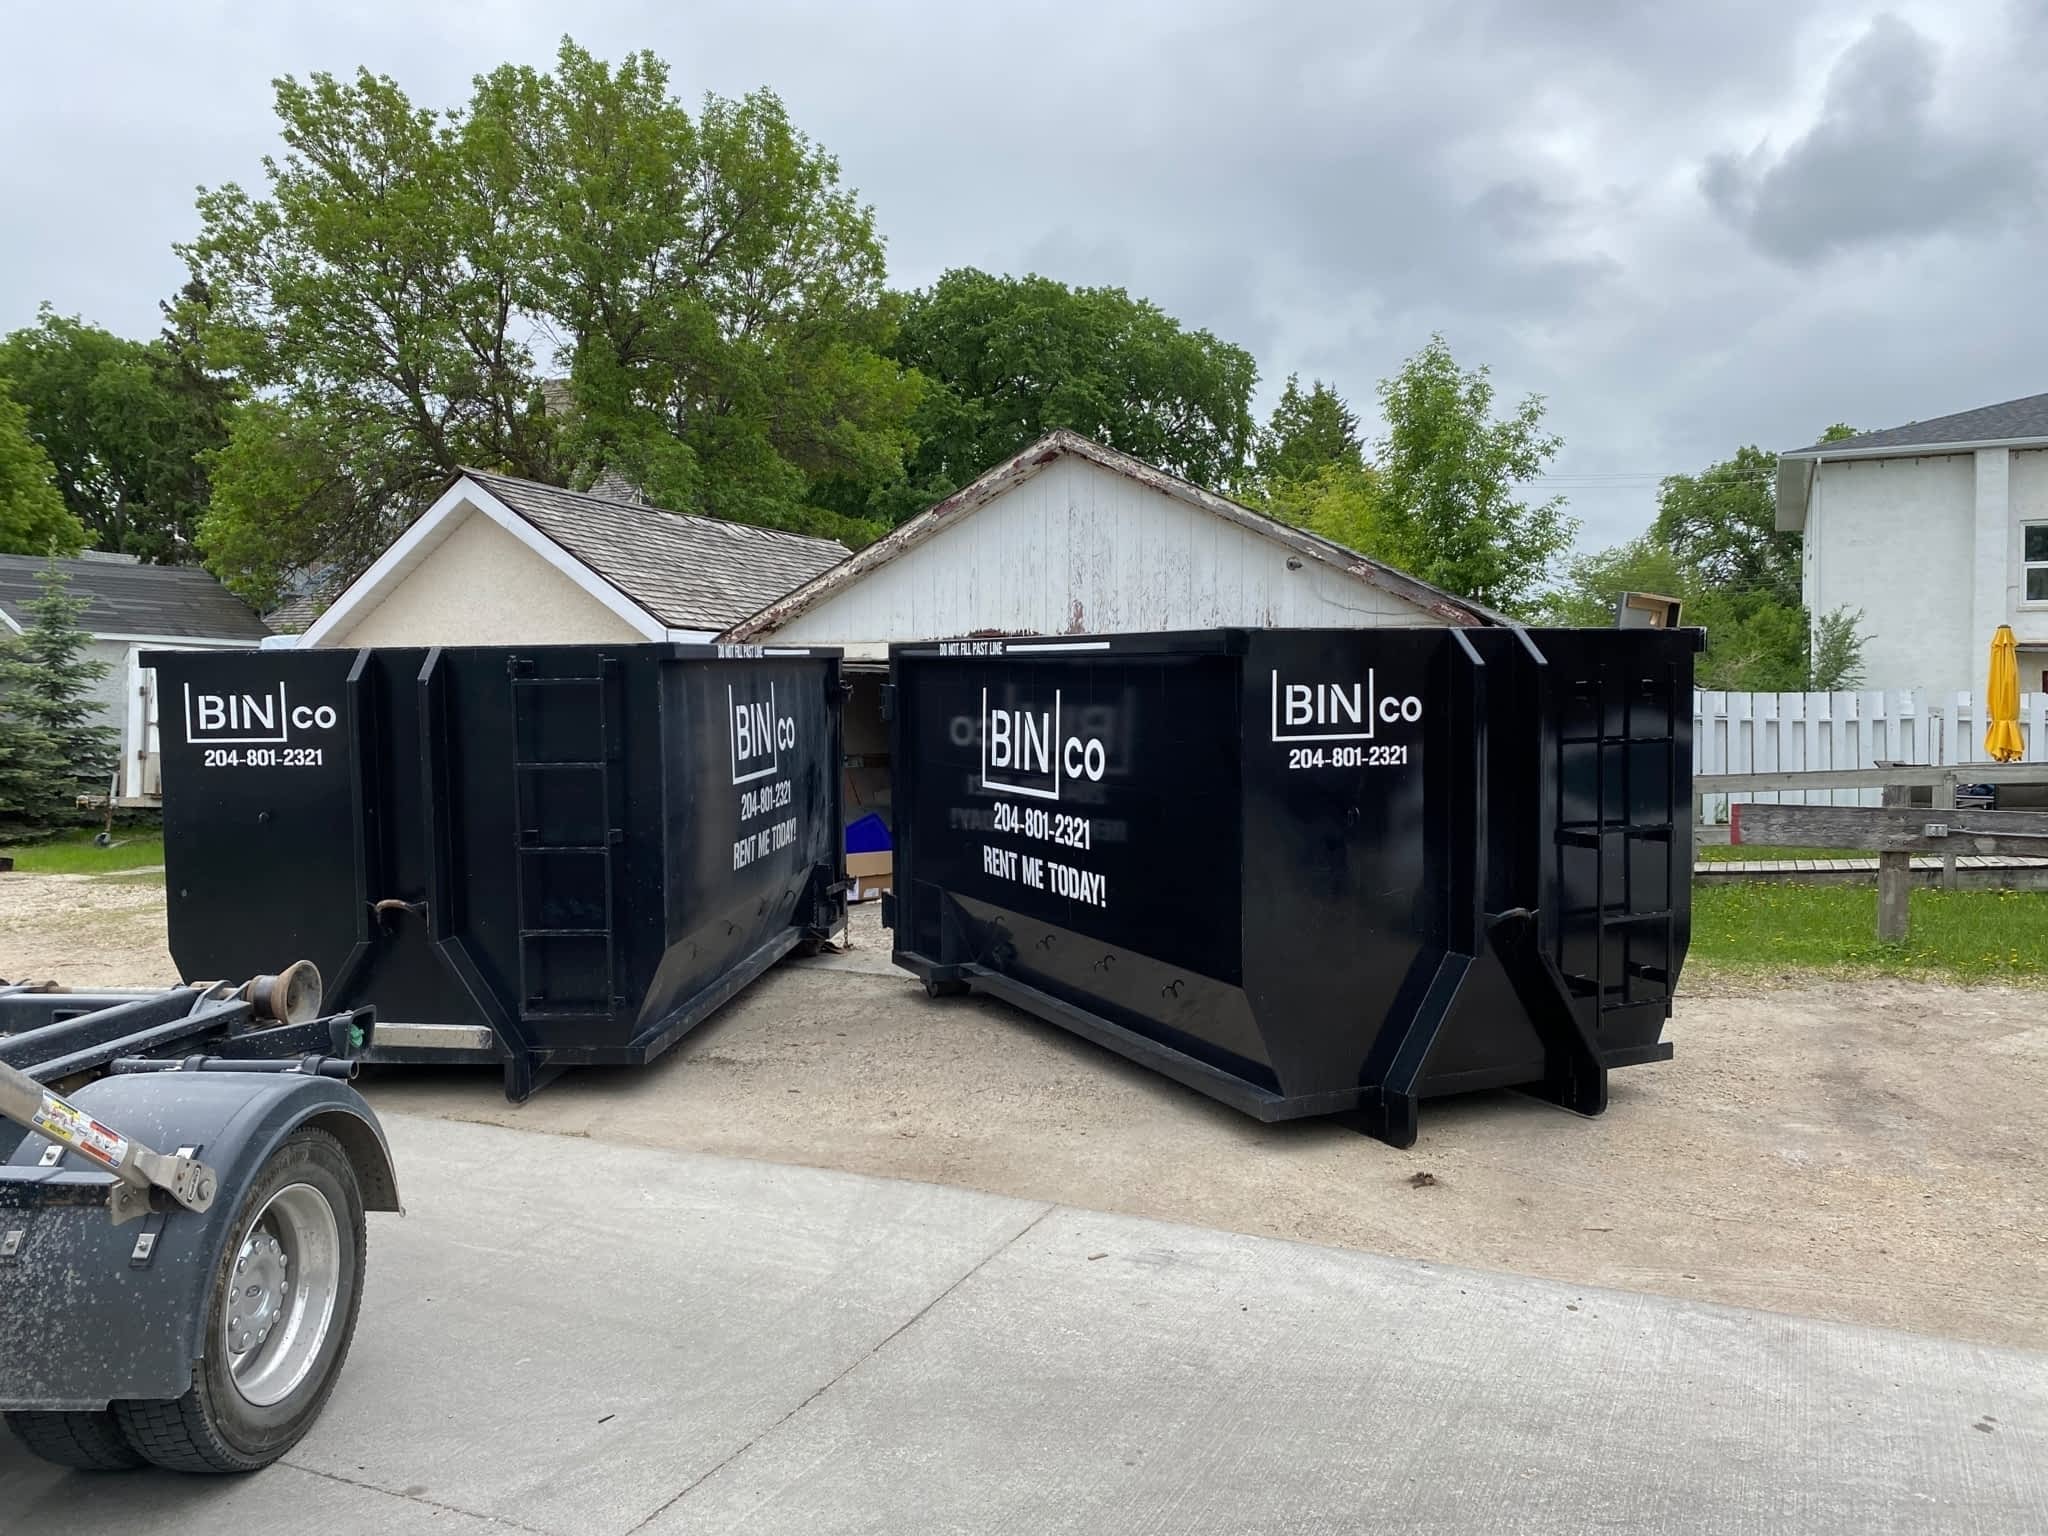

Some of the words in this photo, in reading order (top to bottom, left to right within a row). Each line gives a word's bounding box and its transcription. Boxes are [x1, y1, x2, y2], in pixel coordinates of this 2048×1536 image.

[939, 643, 947, 656] DO
[948, 643, 960, 656] NOT
[960, 642, 972, 656] FILL
[972, 642, 988, 656] PAST
[989, 641, 1003, 655] LINE
[198, 694, 275, 730] BIN
[1285, 683, 1361, 725] BIN
[736, 702, 772, 761] BIN
[991, 709, 1049, 773] BIN
[204, 749, 323, 767] 204-801-2321
[1289, 745, 1408, 769] 204-801-2321
[741, 780, 792, 821] 204-801-2321
[733, 835, 756, 871] RENT
[757, 828, 770, 859] ME
[772, 817, 797, 851] TODAY!
[993, 802, 1091, 850] 204-801-2321
[983, 844, 1018, 881] RENT
[1022, 855, 1044, 890] ME
[1048, 861, 1107, 908] TODAY!
